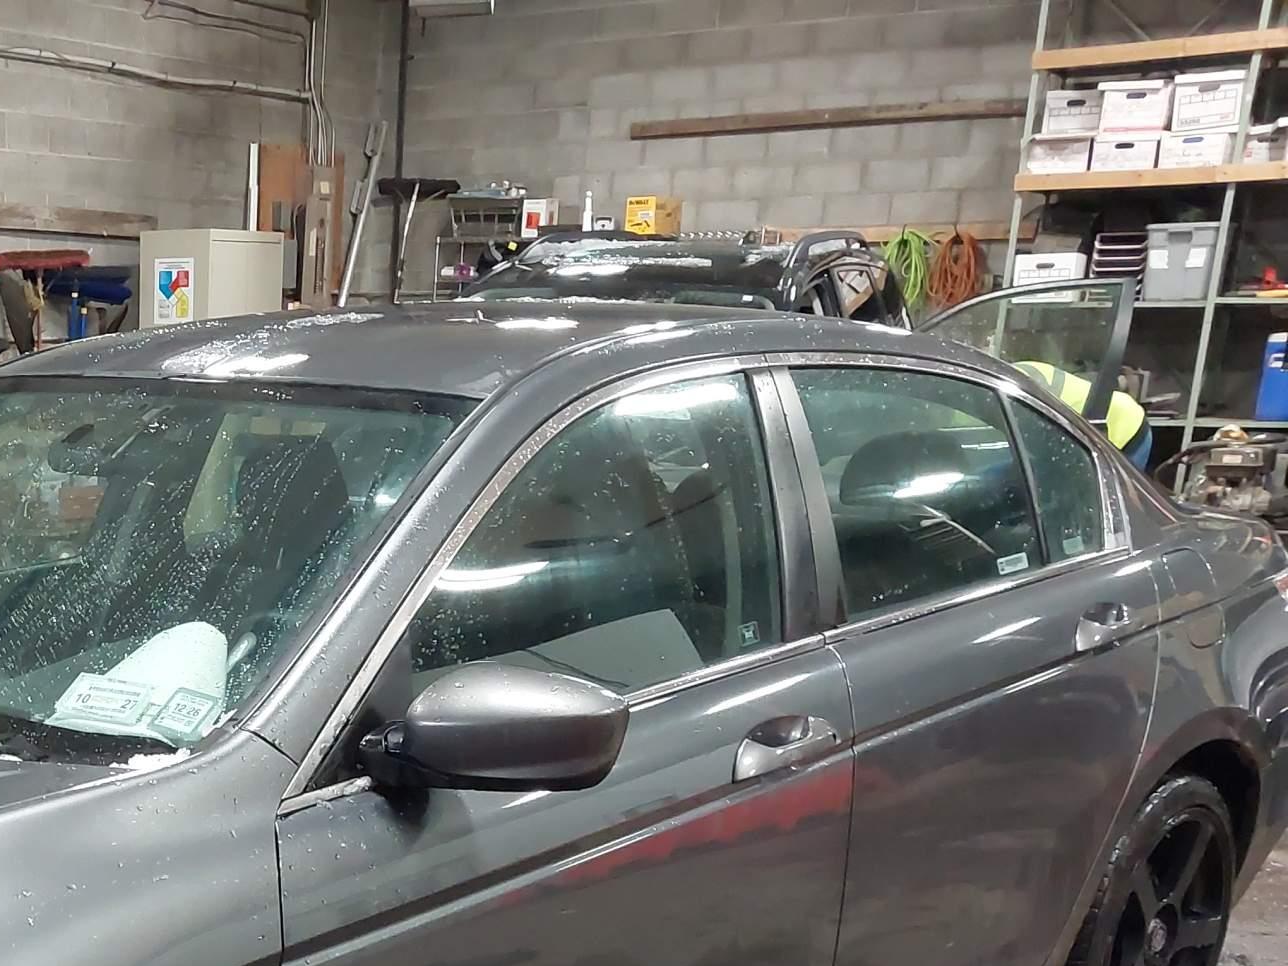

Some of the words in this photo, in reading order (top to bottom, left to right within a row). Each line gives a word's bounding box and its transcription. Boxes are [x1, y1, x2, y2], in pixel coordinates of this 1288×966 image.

[75, 693, 92, 704] 10
[120, 698, 138, 711] 27
[174, 703, 188, 713] 12
